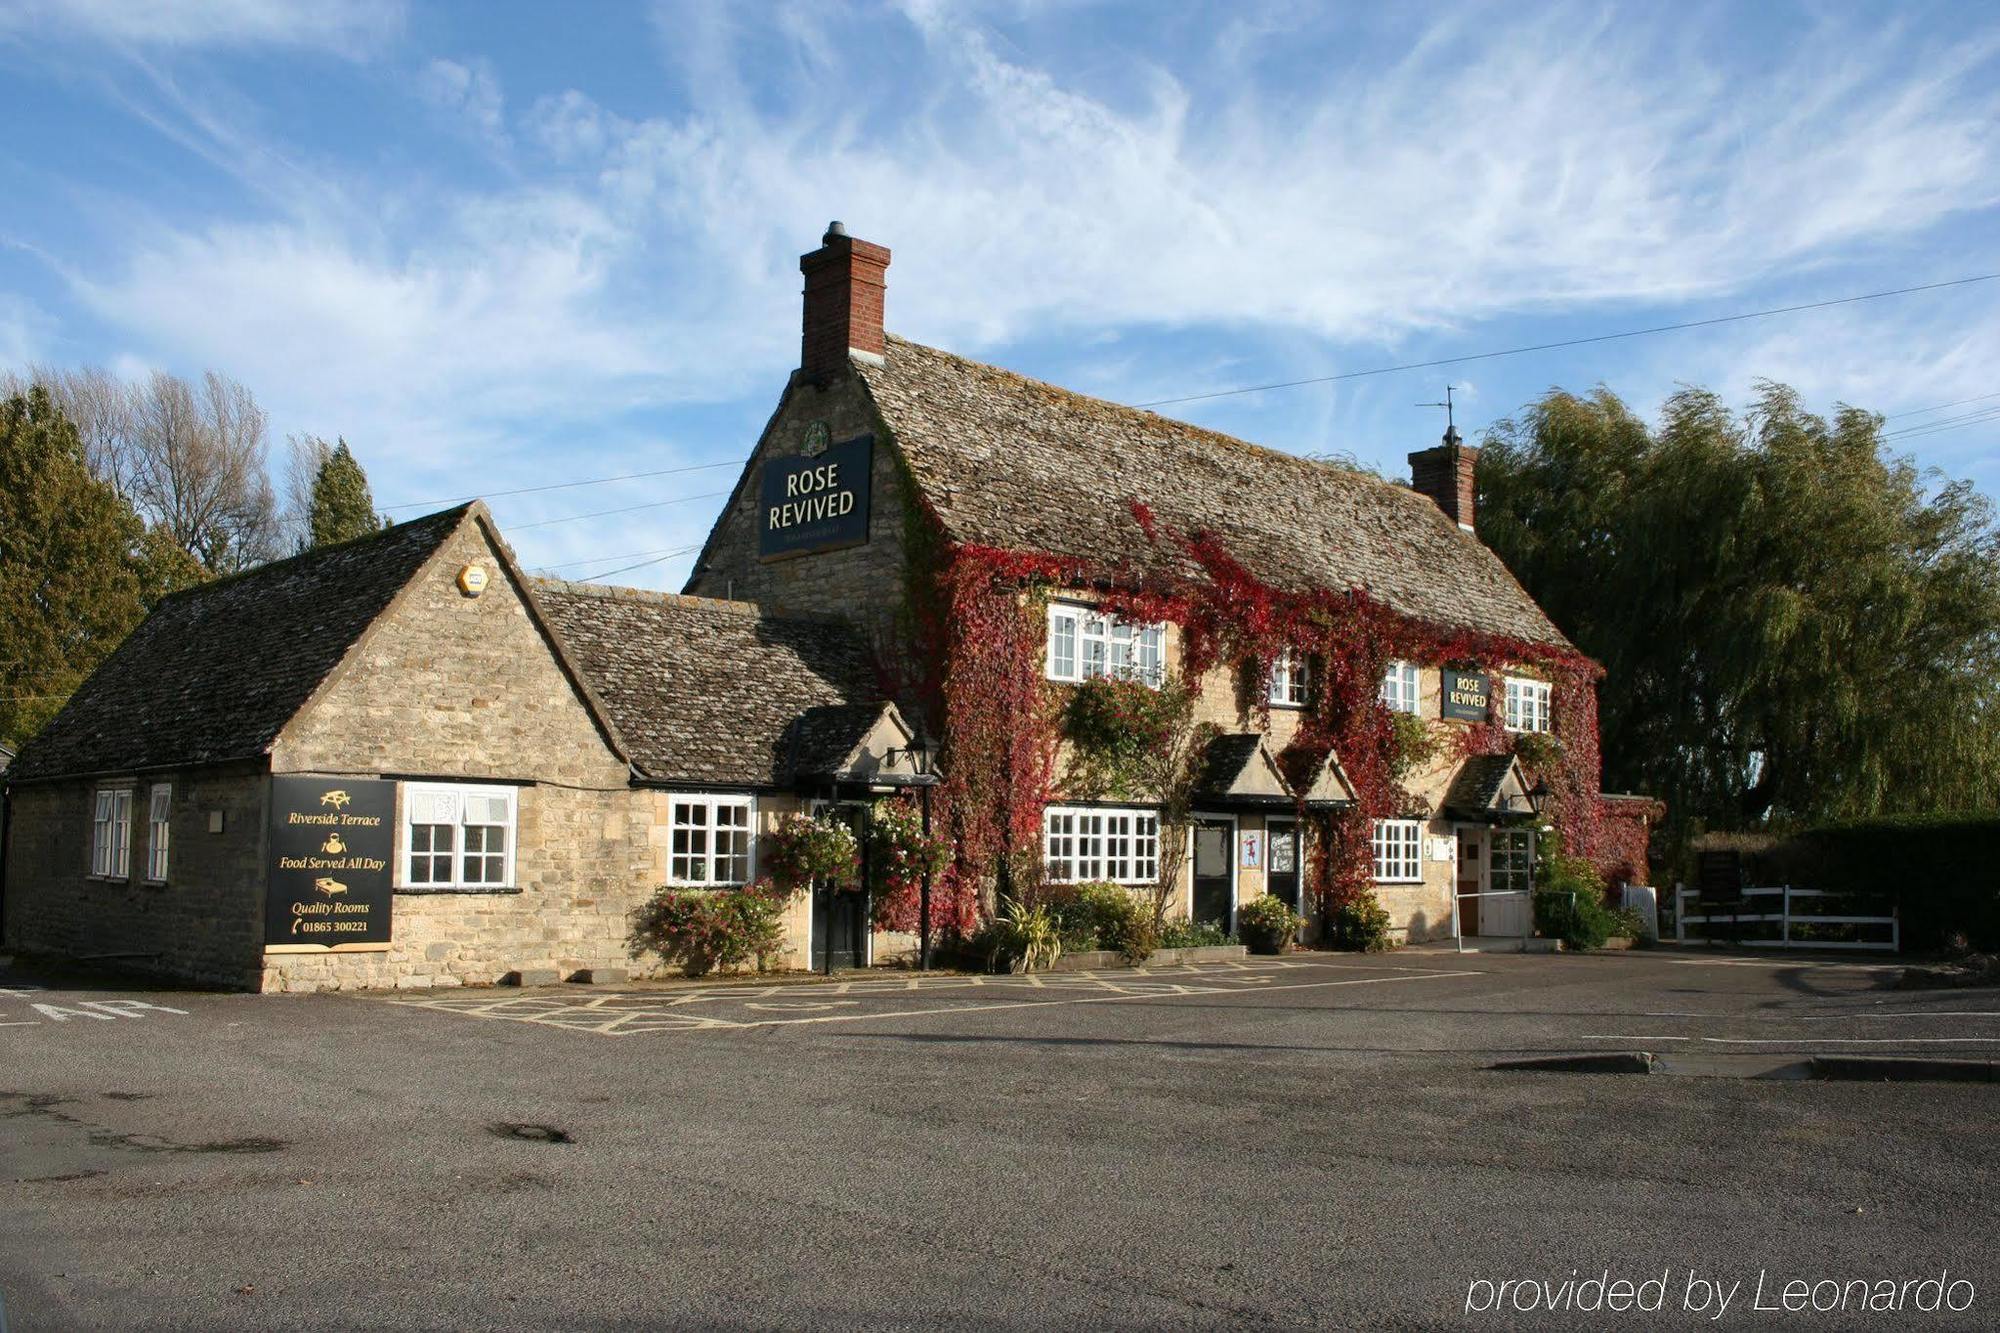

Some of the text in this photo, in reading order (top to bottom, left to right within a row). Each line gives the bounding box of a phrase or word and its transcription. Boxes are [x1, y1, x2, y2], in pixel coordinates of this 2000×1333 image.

[787, 463, 838, 498] ROSE
[769, 491, 854, 530] REVIVED
[1457, 677, 1480, 692] ROSE
[1450, 691, 1486, 708] REVIVED
[288, 812, 381, 826] Riverside Terrace
[280, 856, 386, 872] Food Served All Day
[292, 901, 370, 916] Quality Rooms
[303, 921, 368, 933] 01865 300221
